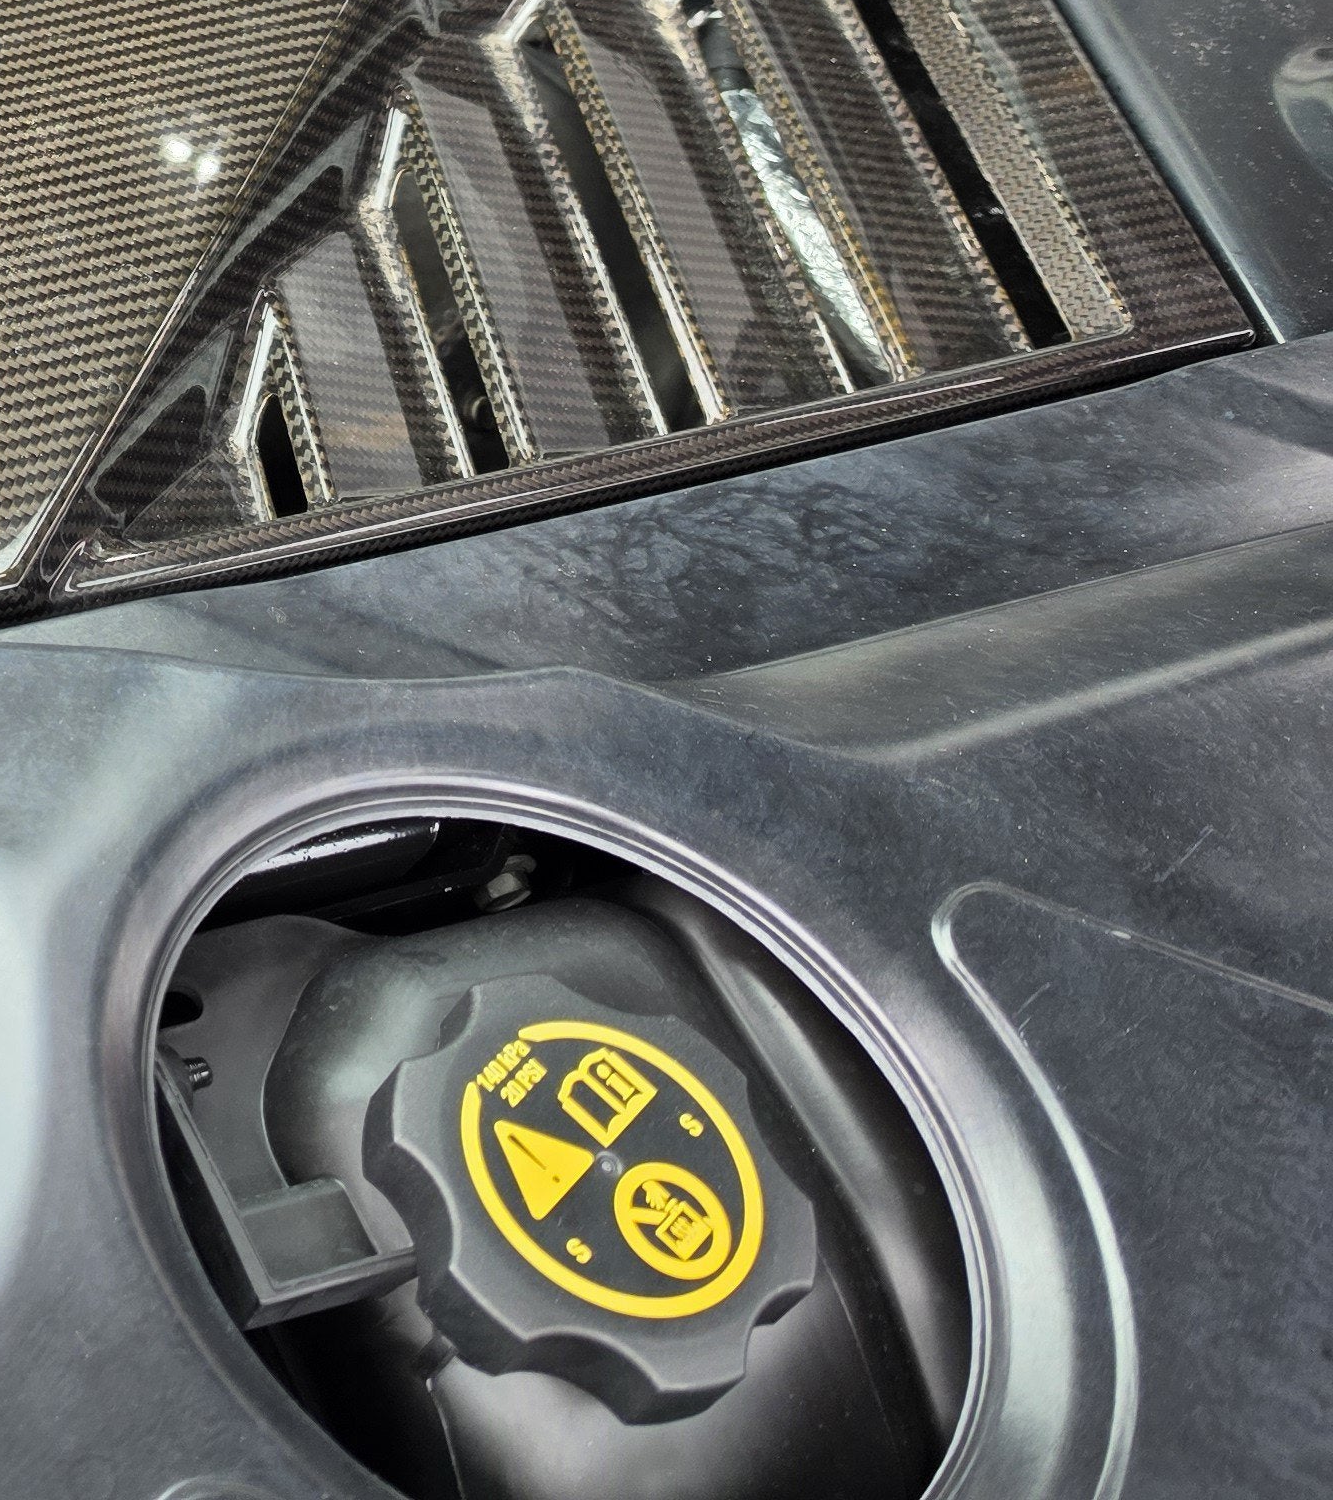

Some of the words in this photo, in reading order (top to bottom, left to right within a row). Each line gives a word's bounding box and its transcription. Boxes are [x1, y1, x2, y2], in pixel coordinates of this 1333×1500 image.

[476, 1060, 509, 1093] 140
[496, 1039, 532, 1072] kPa
[499, 1078, 528, 1109] 20
[514, 1057, 548, 1091] PSI
